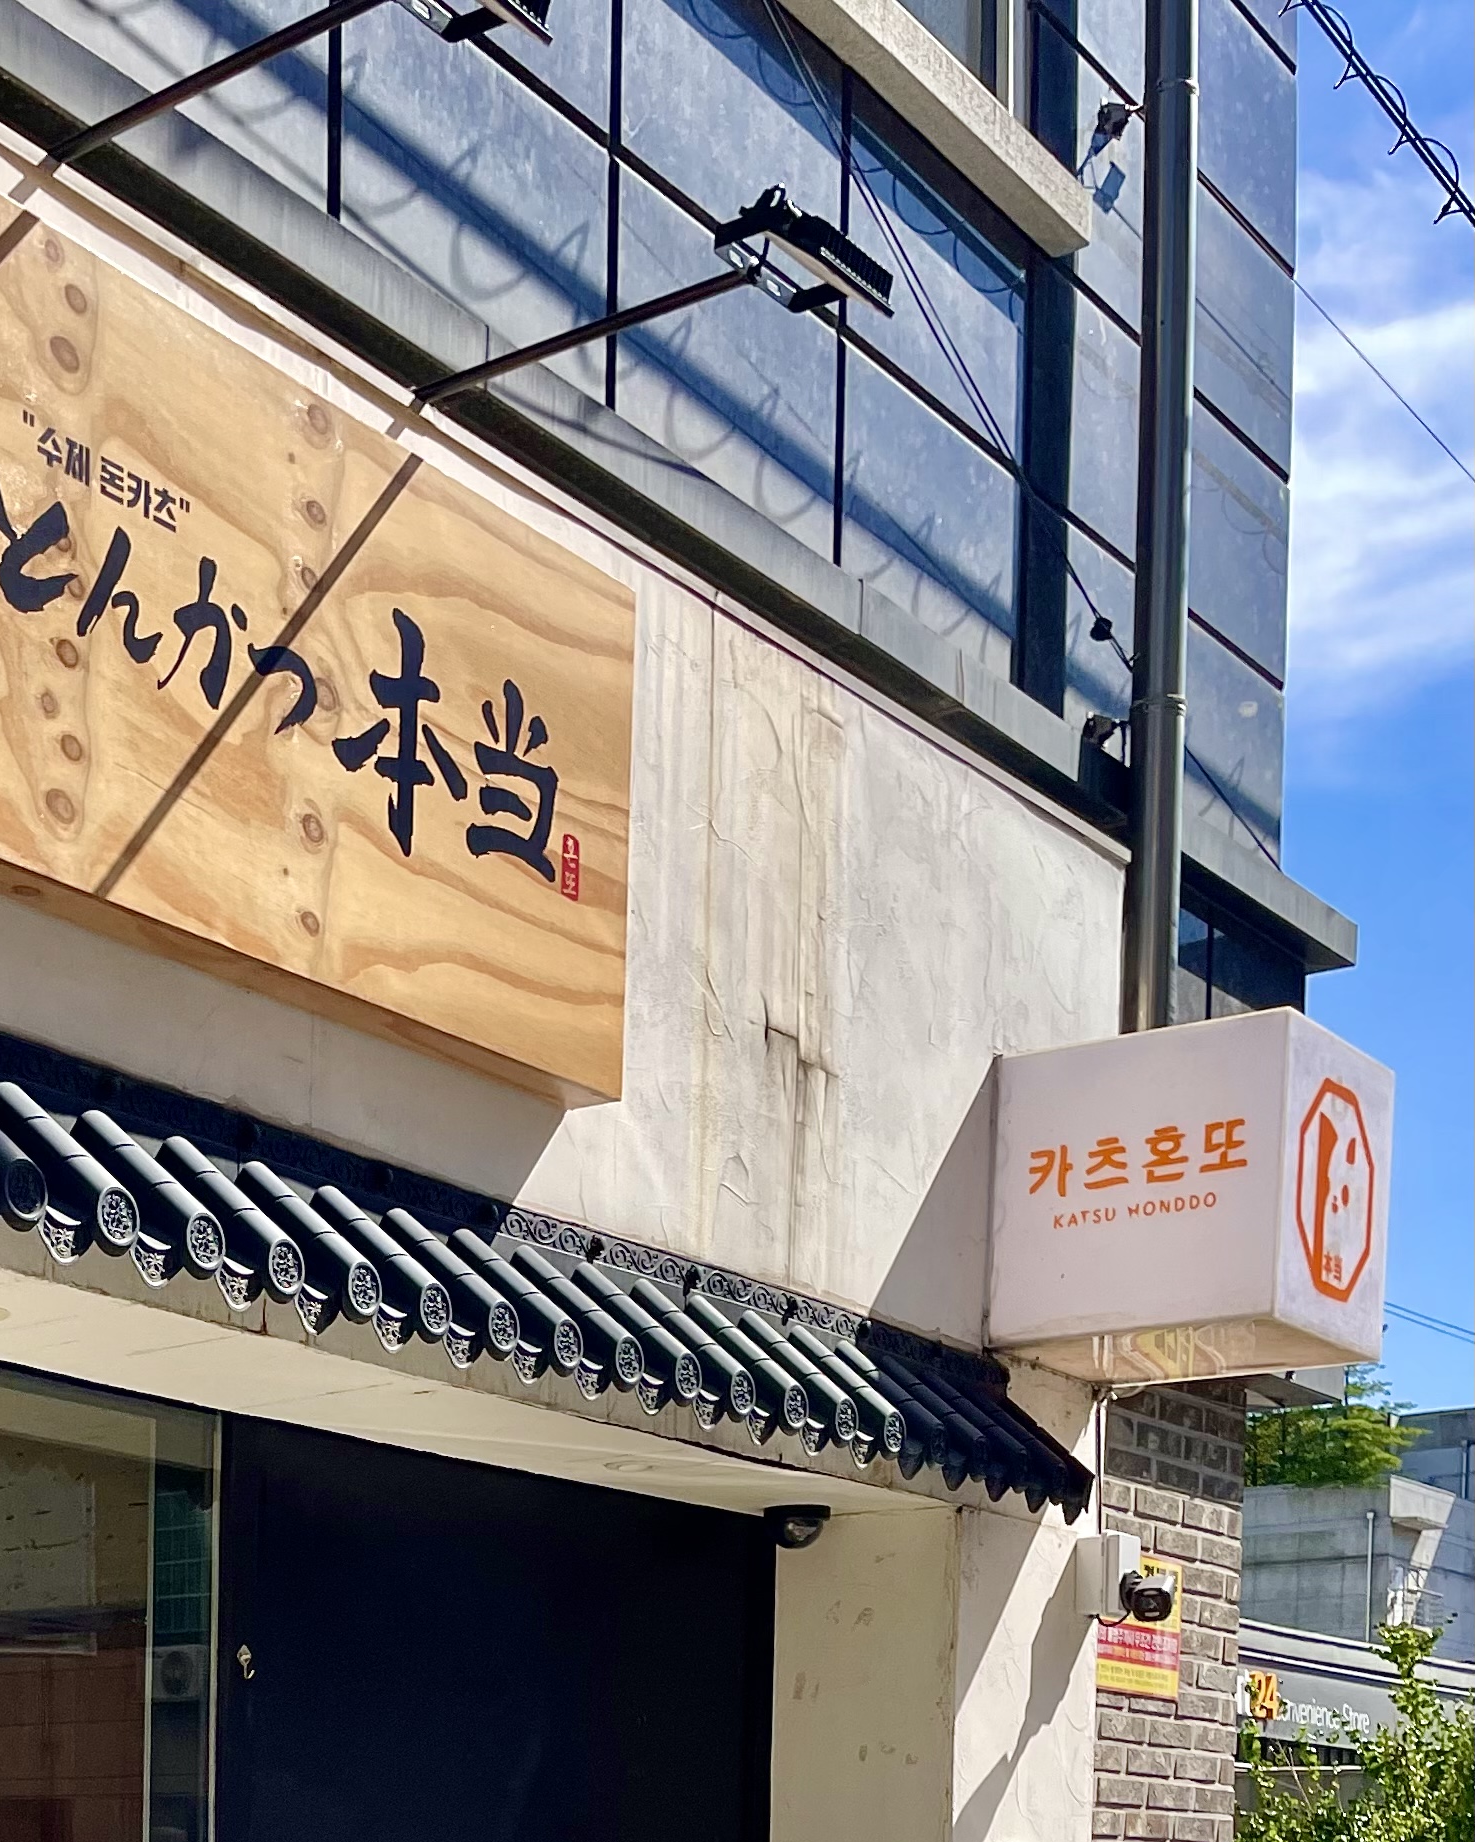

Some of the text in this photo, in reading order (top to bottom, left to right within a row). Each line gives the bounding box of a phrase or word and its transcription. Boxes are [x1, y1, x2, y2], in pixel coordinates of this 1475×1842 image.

[99, 455, 191, 533] 돈카츠"
[1029, 1117, 1248, 1198] 카츠혼또
[1053, 1192, 1218, 1230] KATSU HONDDO
